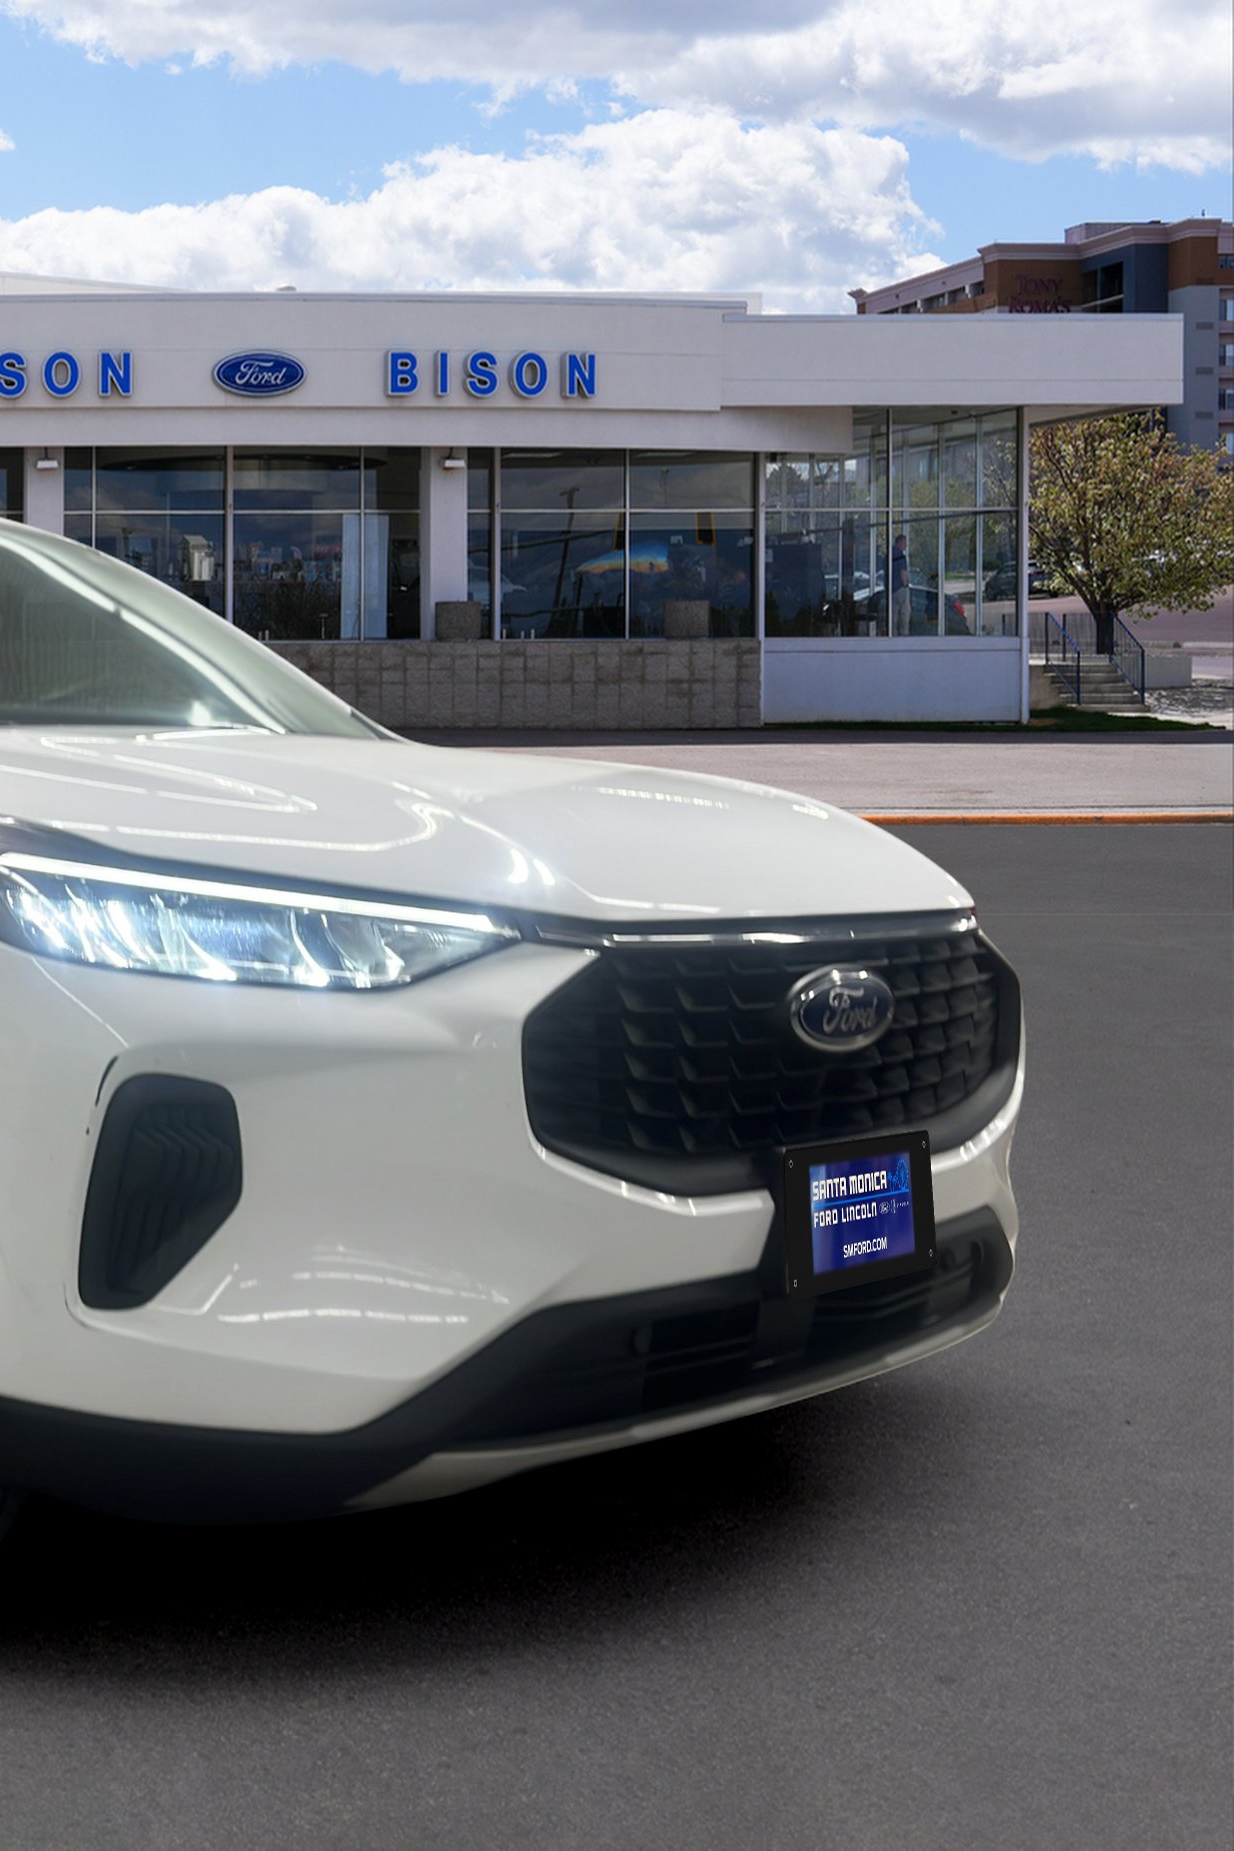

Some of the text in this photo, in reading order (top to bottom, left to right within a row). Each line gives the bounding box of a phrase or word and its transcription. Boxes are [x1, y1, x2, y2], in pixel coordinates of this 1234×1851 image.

[234, 360, 287, 385] Ford
[385, 350, 597, 398] BISON
[822, 985, 878, 1035] Ford
[812, 1170, 887, 1201] SANTA MONICA
[813, 1208, 839, 1229] FORD
[841, 1201, 878, 1223] LINCOLN
[843, 1236, 888, 1259] SMFORD.COM
